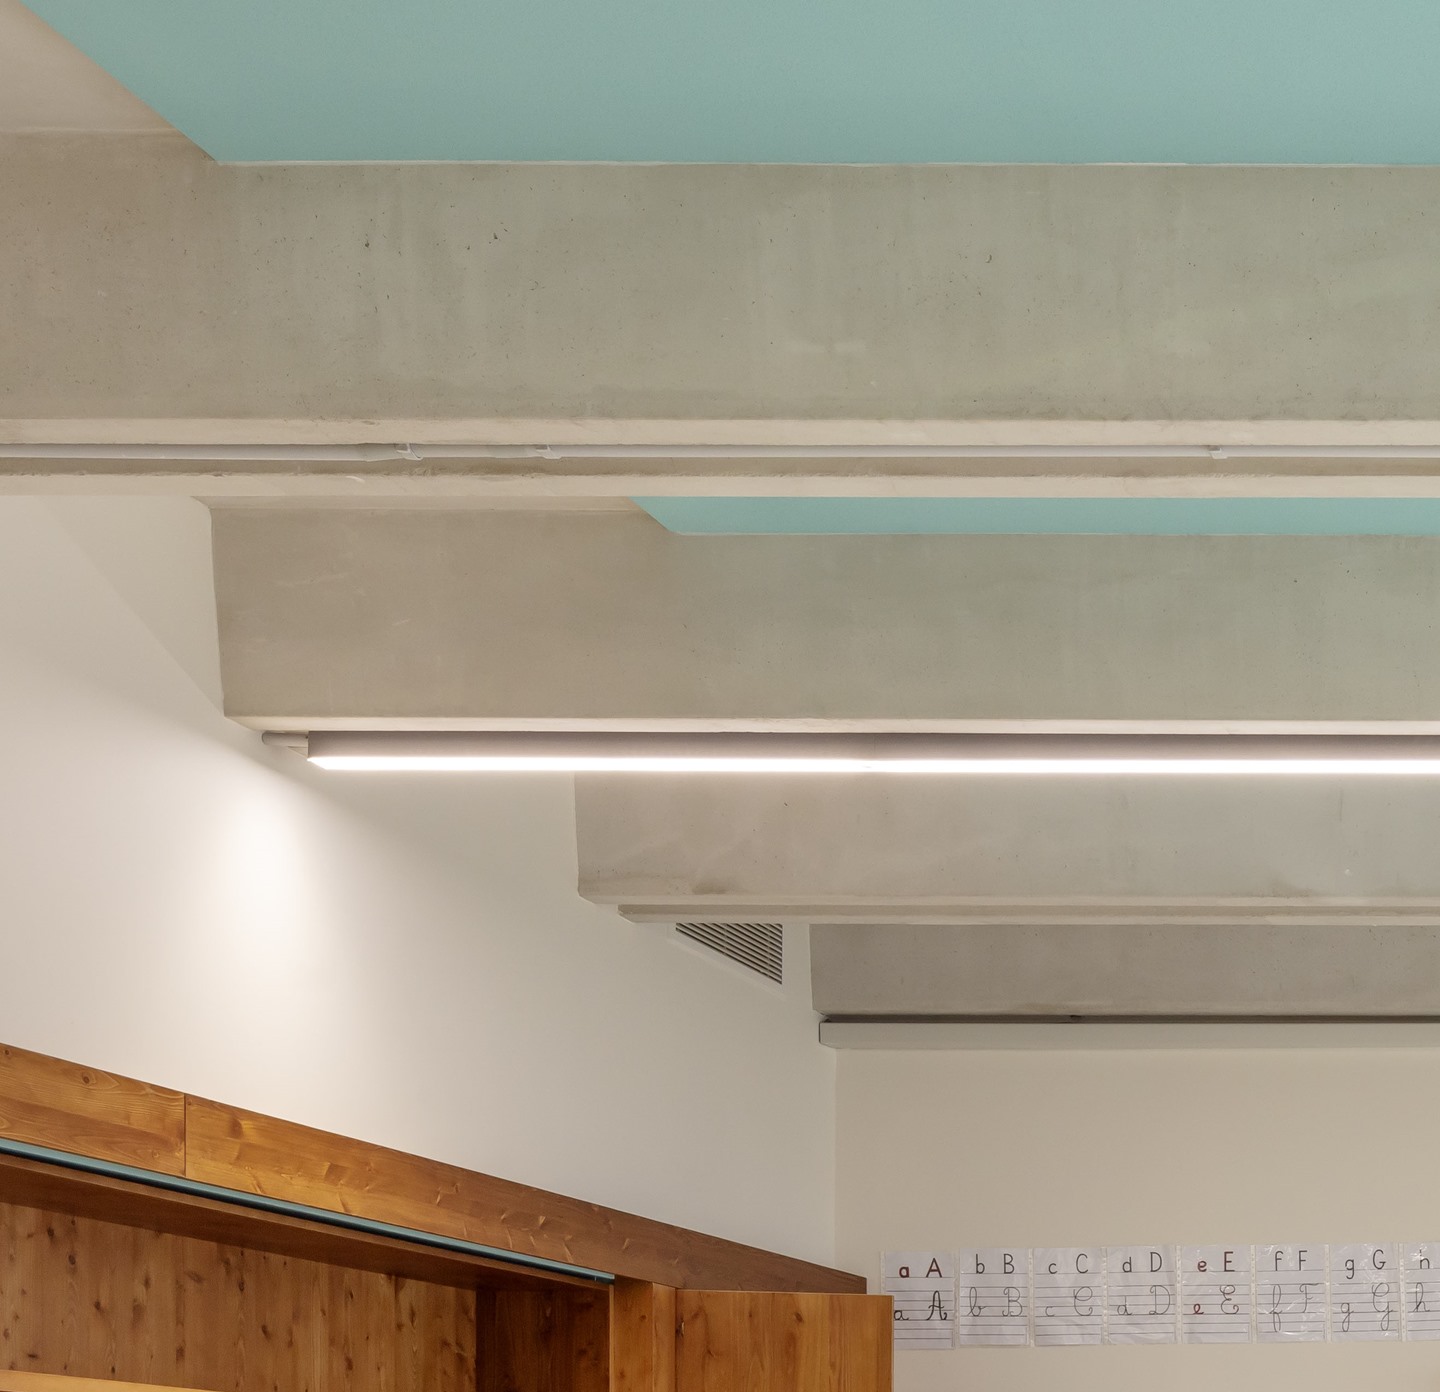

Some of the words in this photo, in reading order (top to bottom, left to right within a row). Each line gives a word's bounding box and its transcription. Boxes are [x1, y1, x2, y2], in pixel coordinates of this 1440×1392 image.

[899, 1265, 910, 1279] a
[925, 1258, 943, 1278] A
[976, 1254, 985, 1274] b
[1003, 1254, 1014, 1274] B
[1048, 1263, 1057, 1274] c
[1076, 1254, 1088, 1274] C
[1122, 1257, 1132, 1273] d
[1150, 1252, 1162, 1272] D
[1197, 1261, 1207, 1272] e
[1223, 1251, 1235, 1272] E
[1275, 1251, 1283, 1271] f
[1299, 1250, 1307, 1271] F
[1345, 1259, 1354, 1279] g
[1373, 1249, 1386, 1270] G
[1420, 1250, 1430, 1269] h
